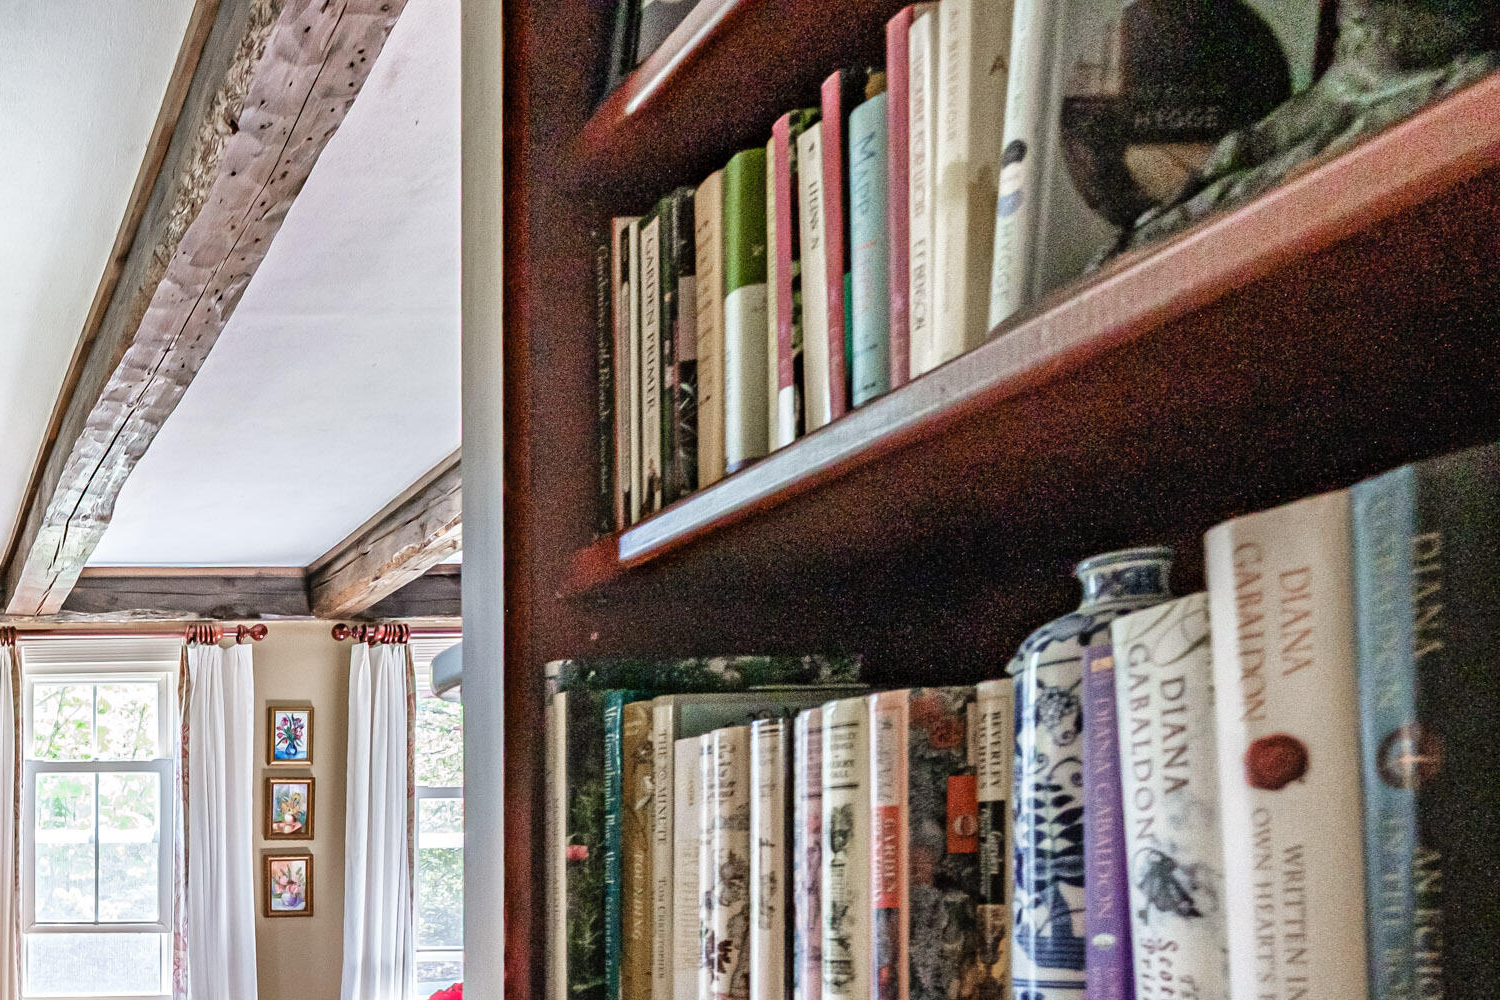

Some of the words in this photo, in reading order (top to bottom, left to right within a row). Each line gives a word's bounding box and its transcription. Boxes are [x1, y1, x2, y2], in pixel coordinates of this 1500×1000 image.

[643, 236, 658, 326] GARDEN
[644, 331, 659, 412] PRIMER
[1233, 542, 1267, 723] GABALDON
[1279, 565, 1314, 677] DIANA
[1410, 531, 1445, 660] DIANA
[656, 729, 669, 757] THE
[979, 712, 989, 790] NICHOLS
[990, 711, 1002, 787] BEVERLEY
[1092, 697, 1115, 774] DIANA
[1127, 643, 1156, 841] GABALDON
[1159, 675, 1190, 795] DIANA
[883, 817, 897, 893] GARDEN
[988, 830, 1004, 875] Garden
[1094, 781, 1117, 920] GABALDON
[1251, 806, 1275, 872] OWN
[1411, 847, 1443, 893] AN
[1253, 881, 1278, 983] HEART'S
[1281, 843, 1310, 967] WRITTEN
